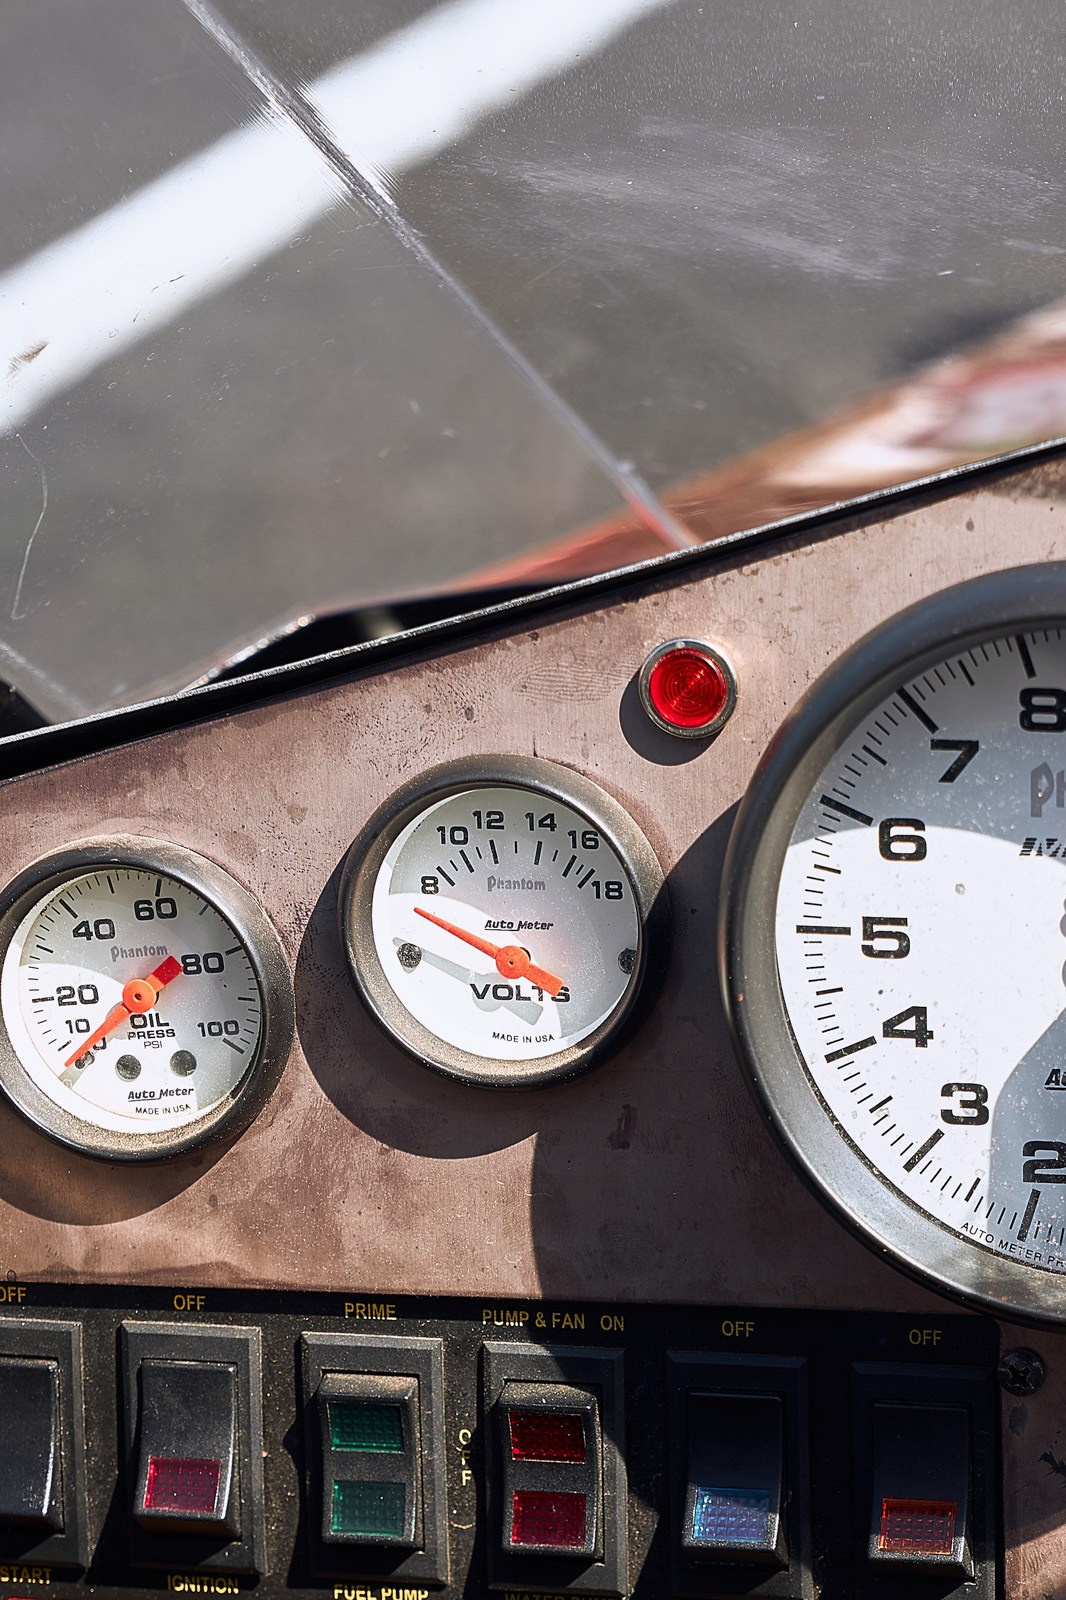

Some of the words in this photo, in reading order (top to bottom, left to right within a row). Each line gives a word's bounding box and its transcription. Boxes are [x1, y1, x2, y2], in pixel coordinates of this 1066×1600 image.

[929, 738, 980, 783] 7
[472, 810, 505, 830] 12
[525, 812, 557, 832] 14
[436, 825, 469, 845] 10
[567, 830, 599, 850] 16
[878, 817, 927, 862] 6
[420, 876, 440, 896] 8
[487, 874, 546, 892] Phantom
[591, 880, 623, 900] 18
[133, 898, 177, 921] 60
[72, 918, 116, 941] 40
[485, 919, 515, 930] Auto
[517, 920, 554, 931] Meter
[860, 916, 911, 960] 5
[111, 943, 168, 962] Phantom
[181, 952, 225, 975] 80
[56, 984, 99, 1006] 20
[65, 1018, 90, 1033] 10
[130, 1013, 169, 1029] OIL
[197, 1020, 239, 1037] 100
[882, 1005, 934, 1048] 4
[128, 1028, 176, 1040] PRESS
[492, 1031, 519, 1042] MADE
[522, 1033, 532, 1043] IN
[535, 1033, 555, 1043] USA
[143, 1041, 163, 1049] PSI
[128, 1091, 155, 1101] Auto
[158, 1088, 194, 1100] Meter
[940, 1082, 990, 1126] 3
[135, 1106, 159, 1115] MADE
[173, 1103, 191, 1113] USA
[961, 1222, 995, 1244] AUTO
[998, 1239, 1042, 1262] METER
[173, 1294, 205, 1311] OFF
[344, 1302, 397, 1321] PRIME
[482, 1309, 529, 1326] PUMP
[535, 1312, 547, 1327] &
[552, 1312, 585, 1329] FAN
[600, 1315, 625, 1331] ON
[721, 1320, 755, 1337] OFF
[909, 1329, 942, 1345] OFF
[0, 1566, 51, 1584] START
[168, 1574, 239, 1594] IGNITION
[334, 1584, 377, 1600] FUEL
